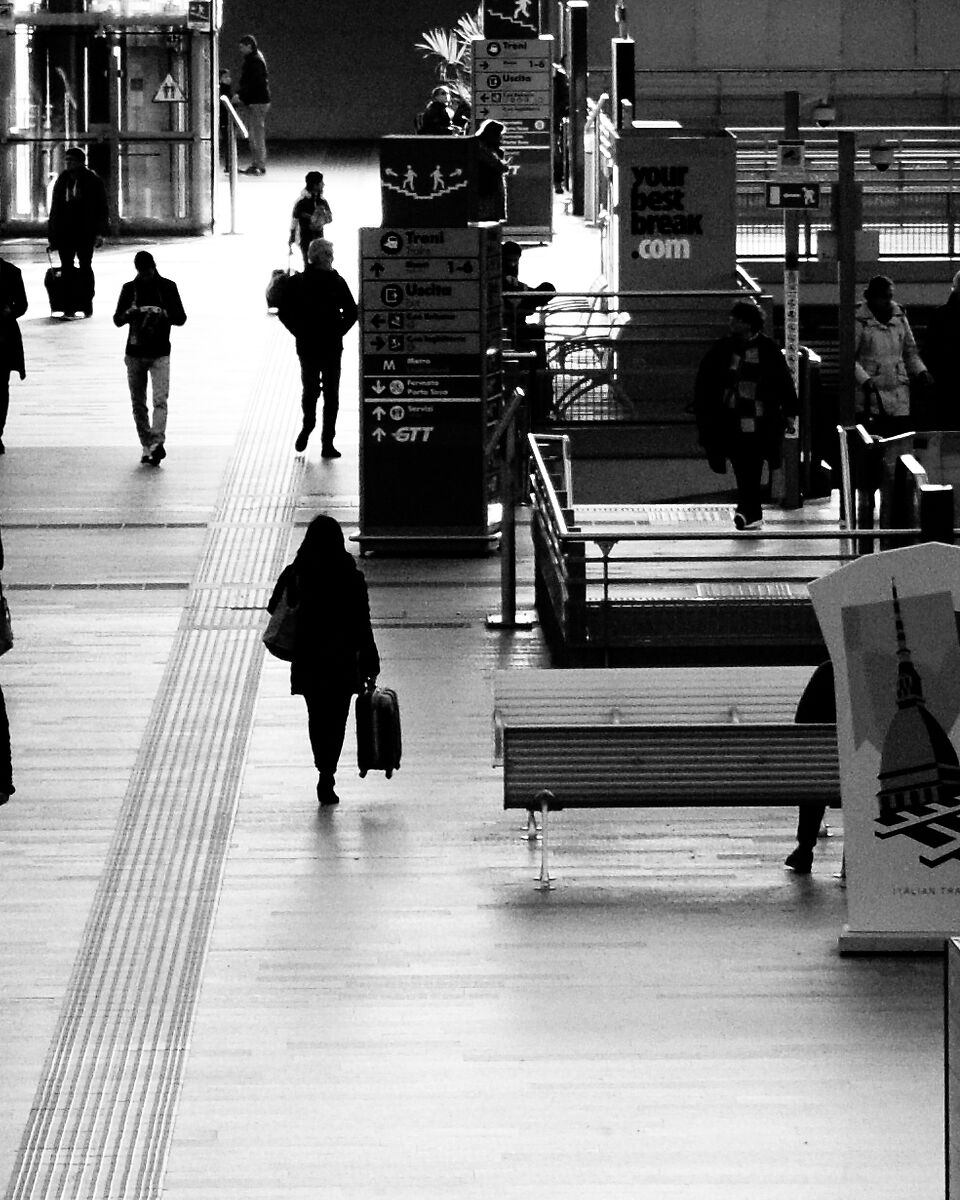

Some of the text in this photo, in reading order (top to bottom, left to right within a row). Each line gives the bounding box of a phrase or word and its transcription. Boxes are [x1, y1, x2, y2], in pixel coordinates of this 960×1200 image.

[529, 60, 545, 68] 1-6
[631, 166, 688, 192] your
[631, 187, 684, 211] best
[631, 211, 703, 235] break
[405, 231, 444, 244] Treni
[631, 238, 690, 260] .com
[447, 261, 473, 274] 1-6
[405, 283, 452, 297] Uscita
[391, 426, 435, 443] GTT
